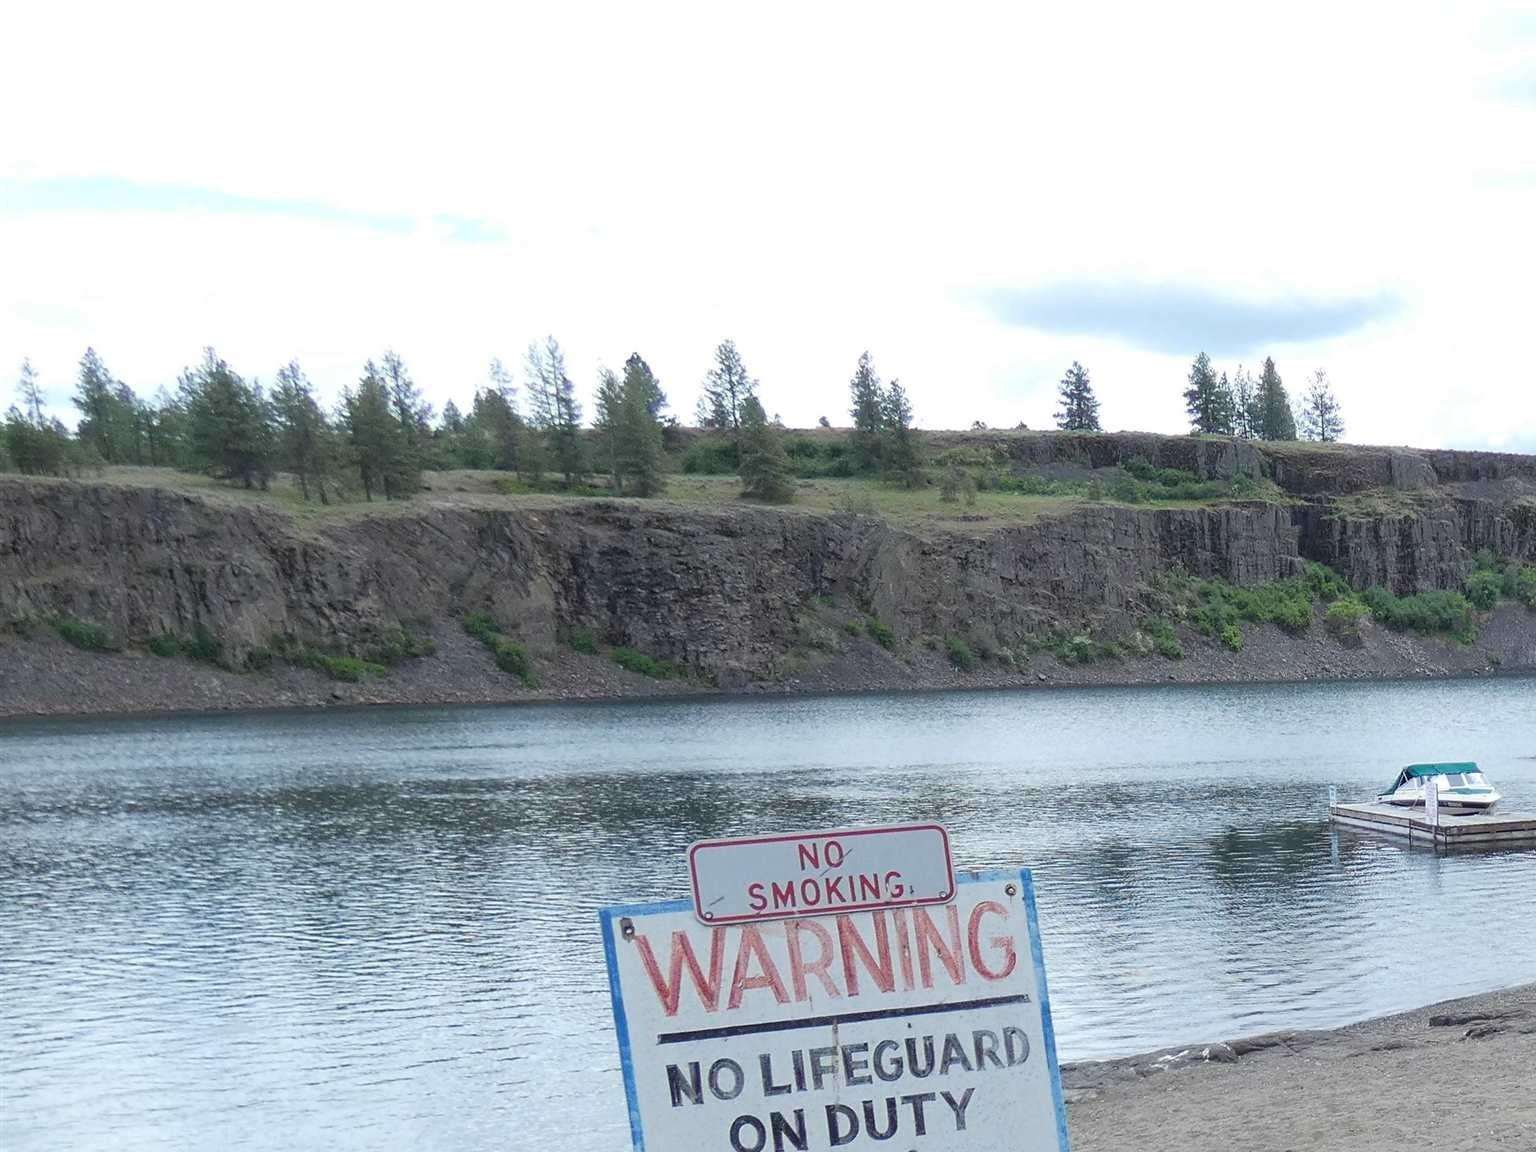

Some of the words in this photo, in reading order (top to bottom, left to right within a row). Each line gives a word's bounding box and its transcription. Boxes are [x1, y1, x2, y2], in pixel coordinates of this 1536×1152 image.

[798, 840, 845, 871] NO
[747, 871, 904, 910] SMOKING
[635, 900, 1017, 1017] WARNING
[665, 1058, 745, 1107] NO
[759, 1025, 1031, 1097] LIFEGUARD
[825, 1087, 975, 1147] DUTY
